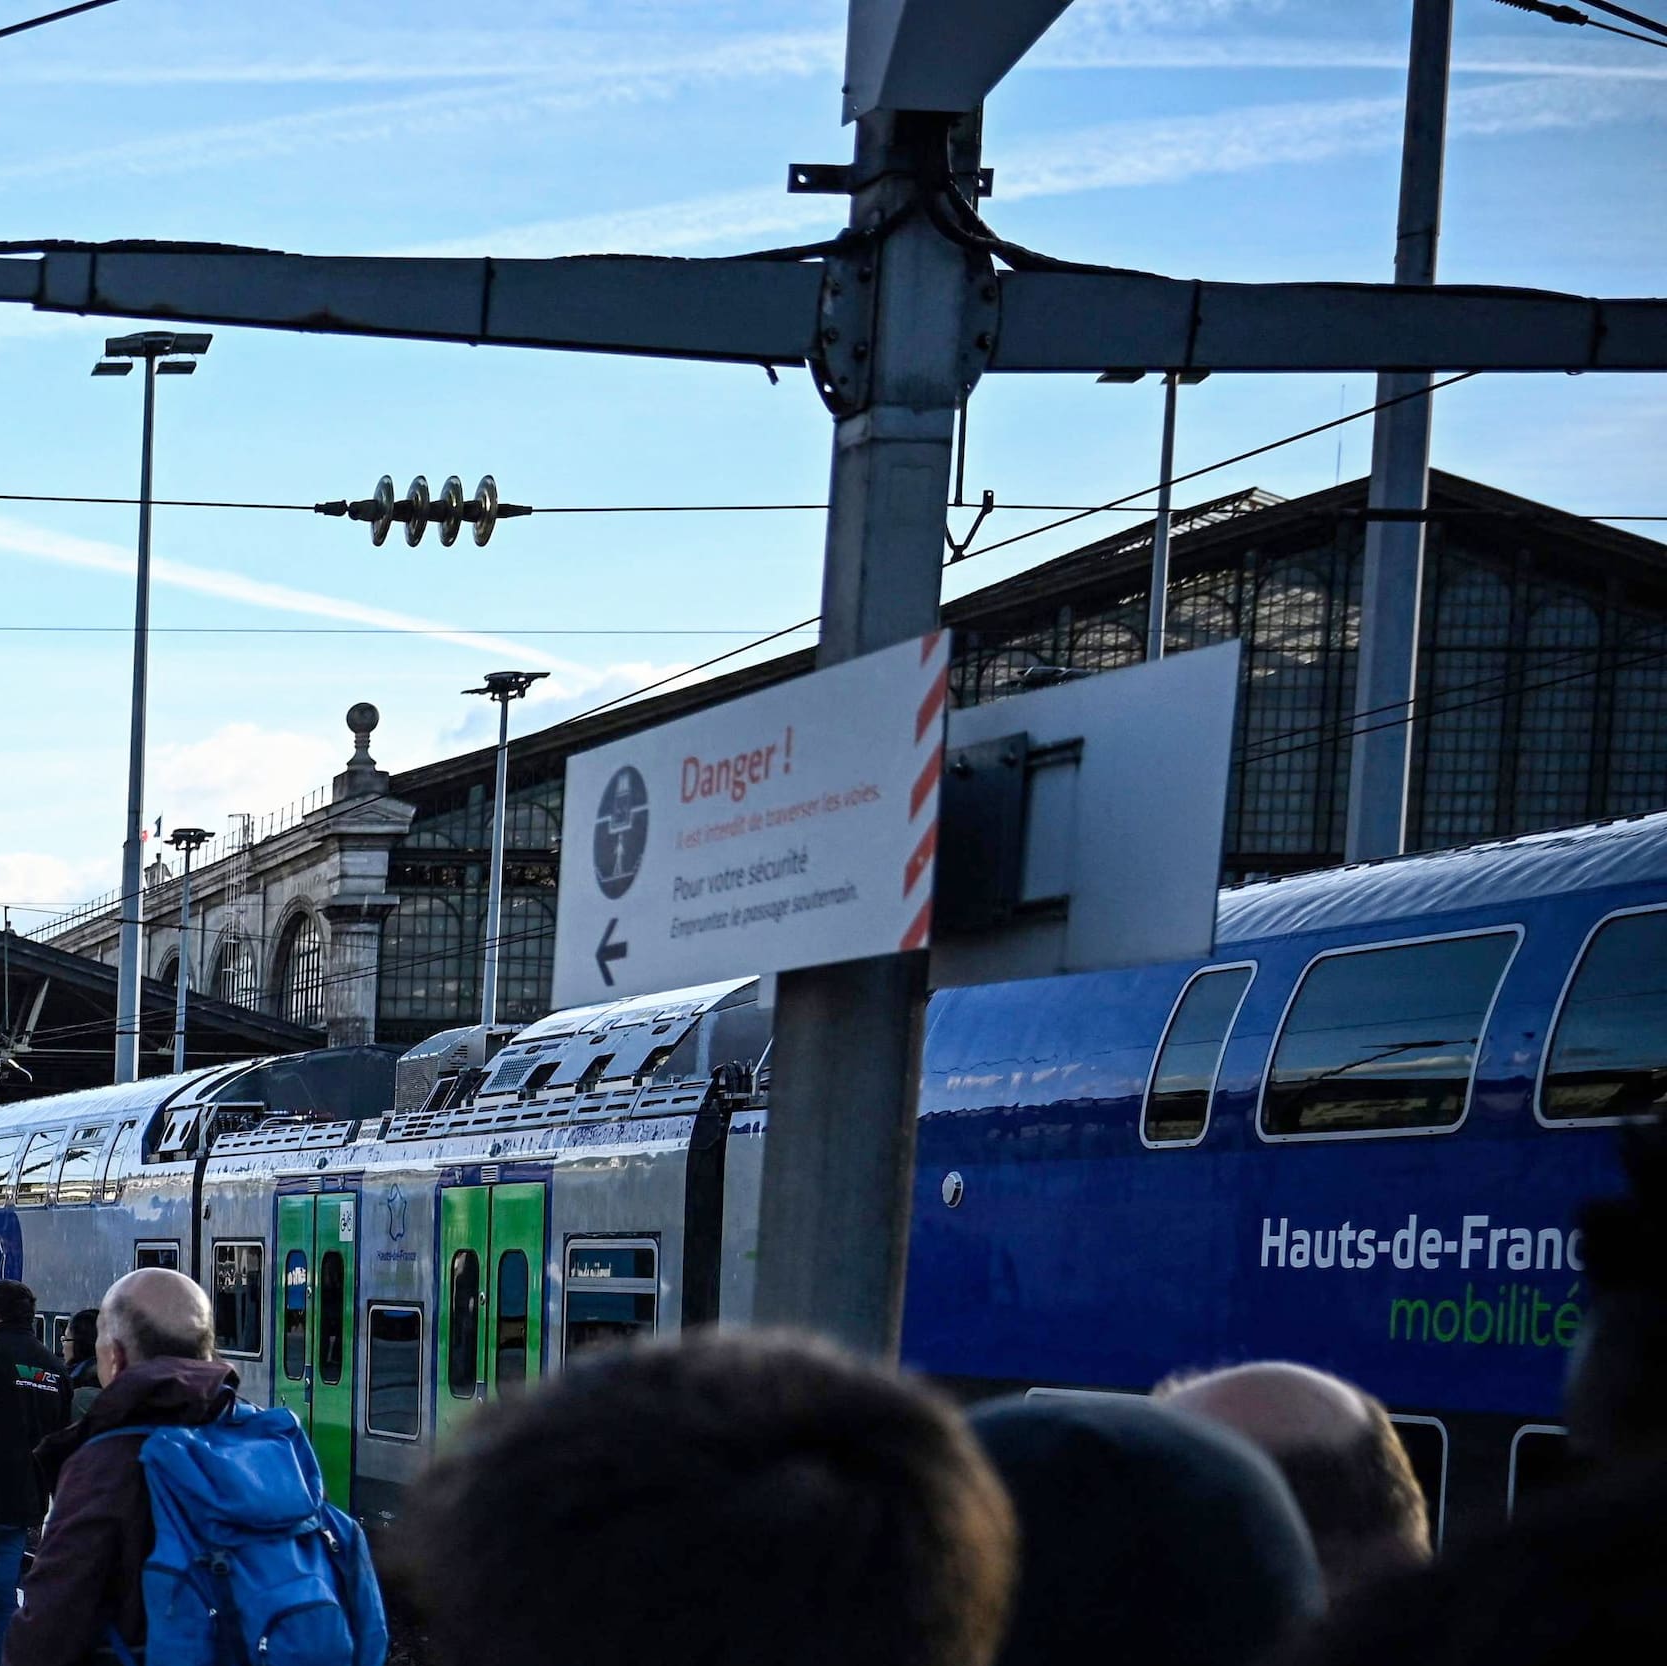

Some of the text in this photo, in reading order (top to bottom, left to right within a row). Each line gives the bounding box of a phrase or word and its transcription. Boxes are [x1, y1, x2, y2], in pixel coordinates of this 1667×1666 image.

[681, 725, 793, 803] Danger !
[673, 847, 808, 901] Pour votre sécurité
[670, 912, 729, 940] Empruntez
[743, 899, 790, 930] passage
[1260, 1214, 1587, 1272] Hauts-de-Franc
[1389, 1281, 1586, 1347] mobilité
